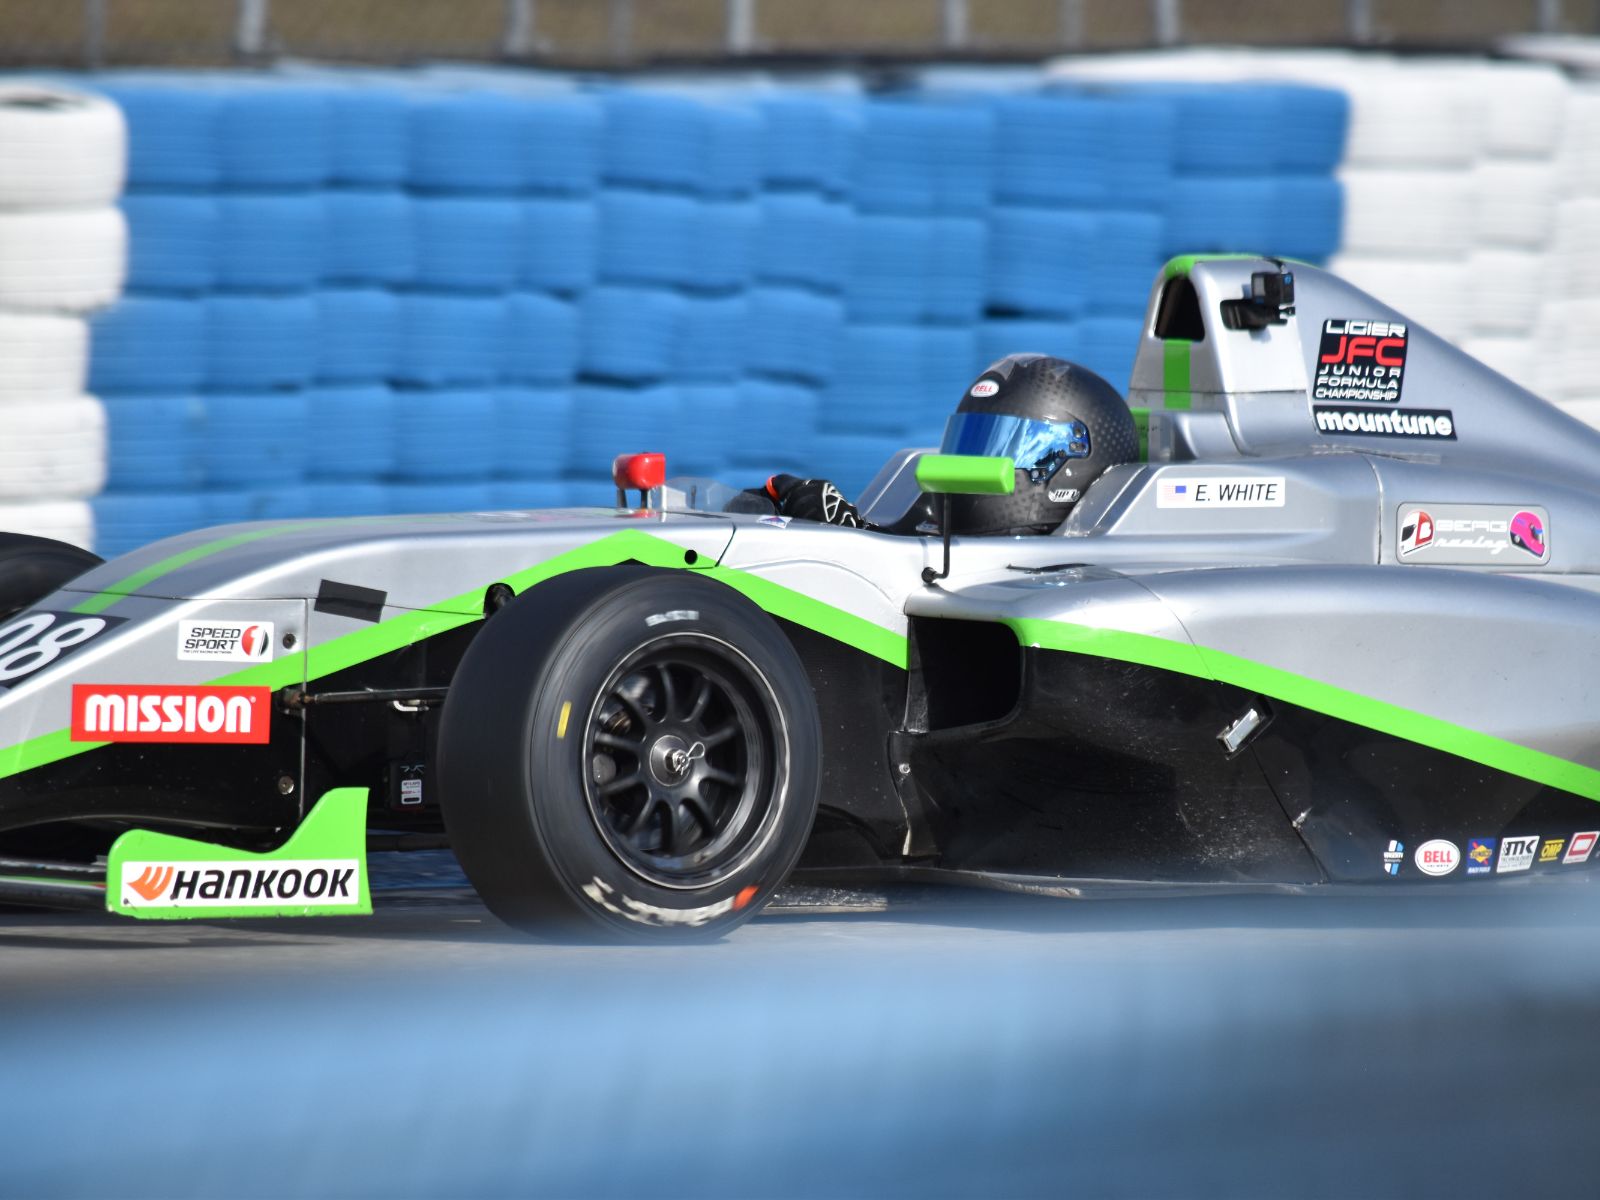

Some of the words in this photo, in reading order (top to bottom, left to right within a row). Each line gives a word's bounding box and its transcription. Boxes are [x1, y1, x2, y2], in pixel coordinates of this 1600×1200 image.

[1326, 320, 1406, 337] LIGIER
[1321, 336, 1405, 366] JFC
[1319, 364, 1401, 378] JUNIOR
[1317, 376, 1398, 390] FORMULA
[1315, 387, 1397, 401] CHAMPIONSHIP
[1316, 409, 1452, 436] mountune
[1195, 484, 1211, 502] E.
[1219, 483, 1278, 502] WHITE
[190, 627, 241, 639] SPEED
[184, 639, 240, 650] SPORT
[85, 694, 252, 734] MISSION
[1424, 851, 1452, 863] BELL
[1541, 843, 1563, 858] OMP
